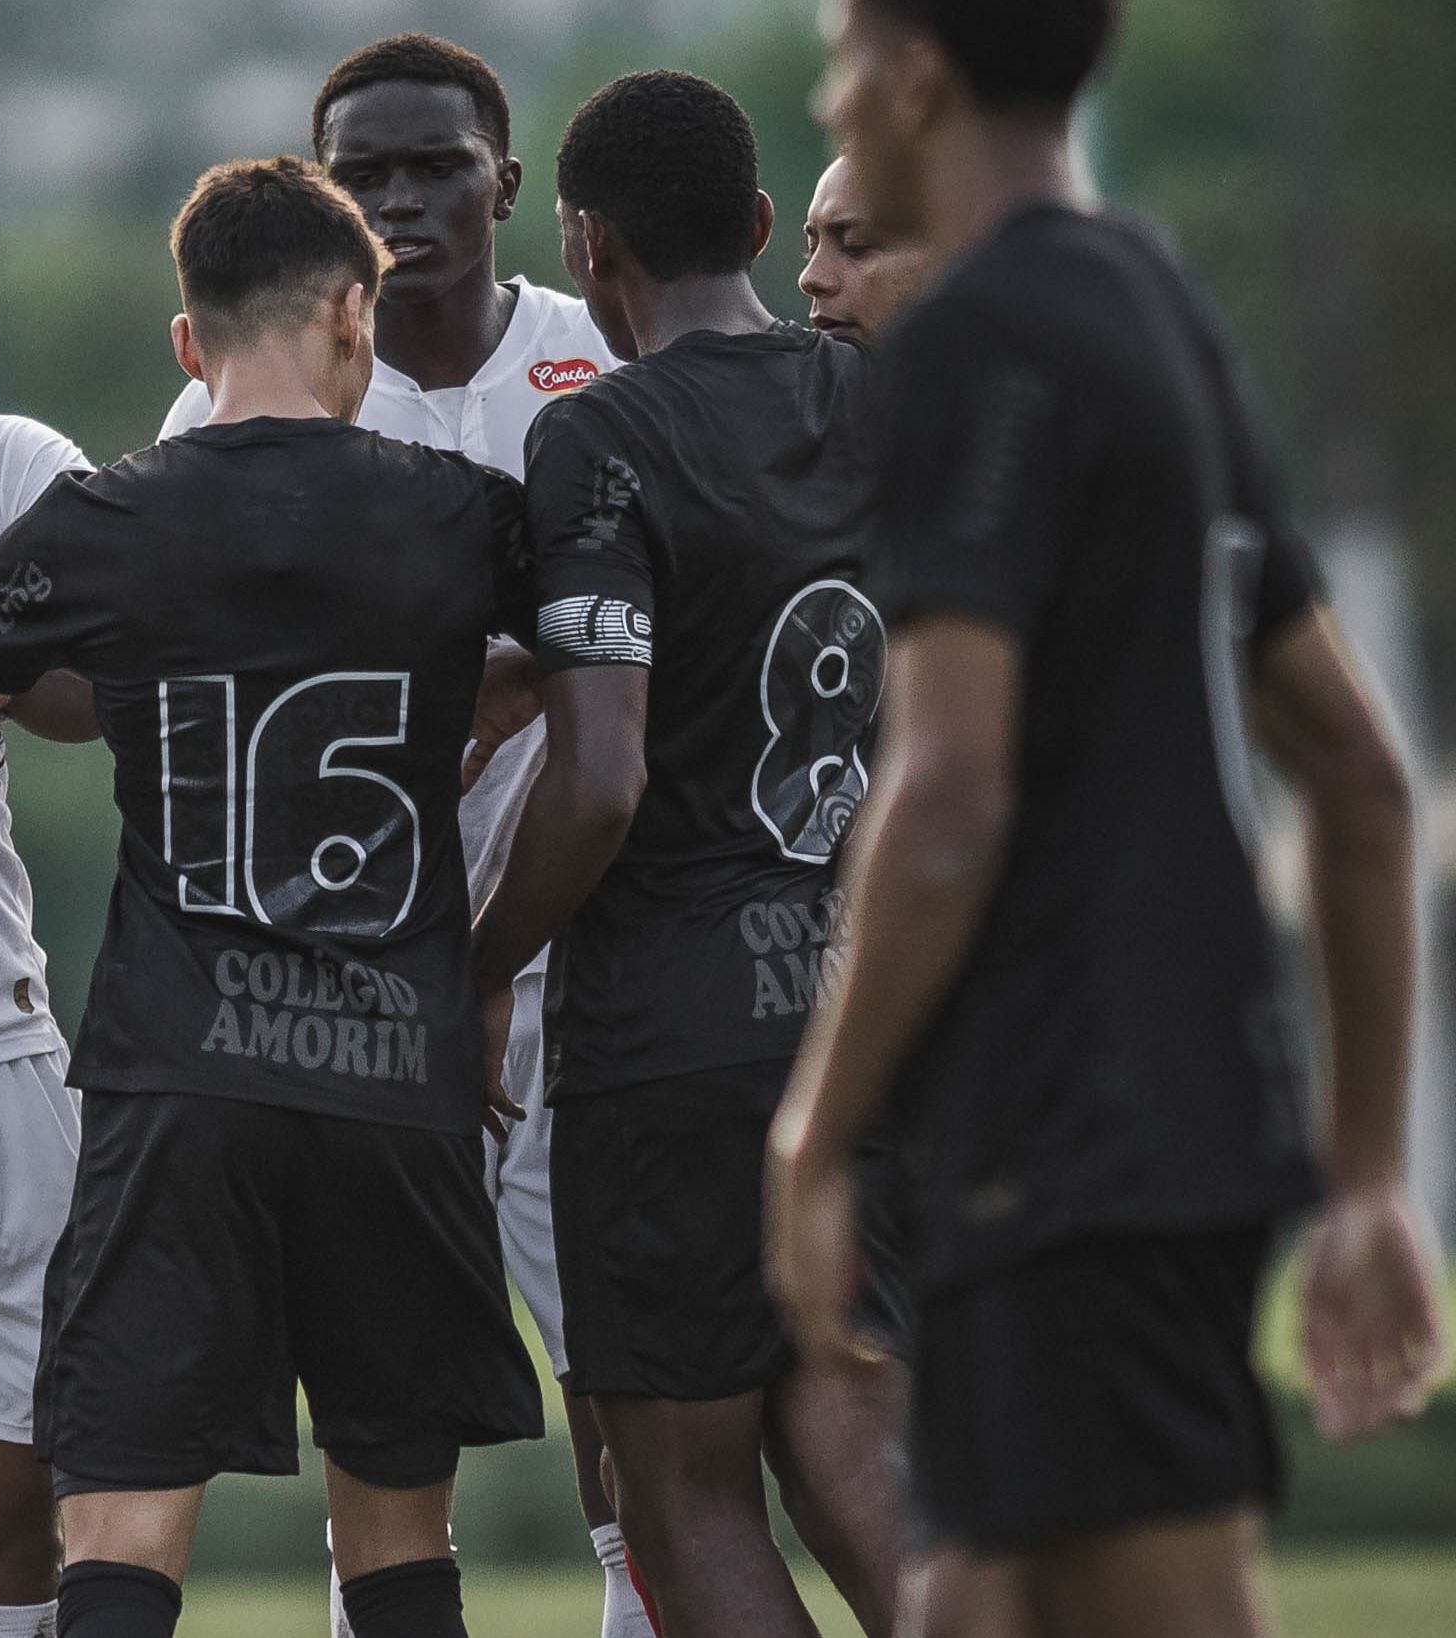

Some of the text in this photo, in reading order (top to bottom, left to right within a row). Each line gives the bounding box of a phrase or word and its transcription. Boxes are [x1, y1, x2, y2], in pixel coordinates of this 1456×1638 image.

[532, 365, 595, 389] Canção
[158, 671, 421, 938] 16
[751, 579, 888, 865] 8
[200, 999, 429, 1084] AMORIM
